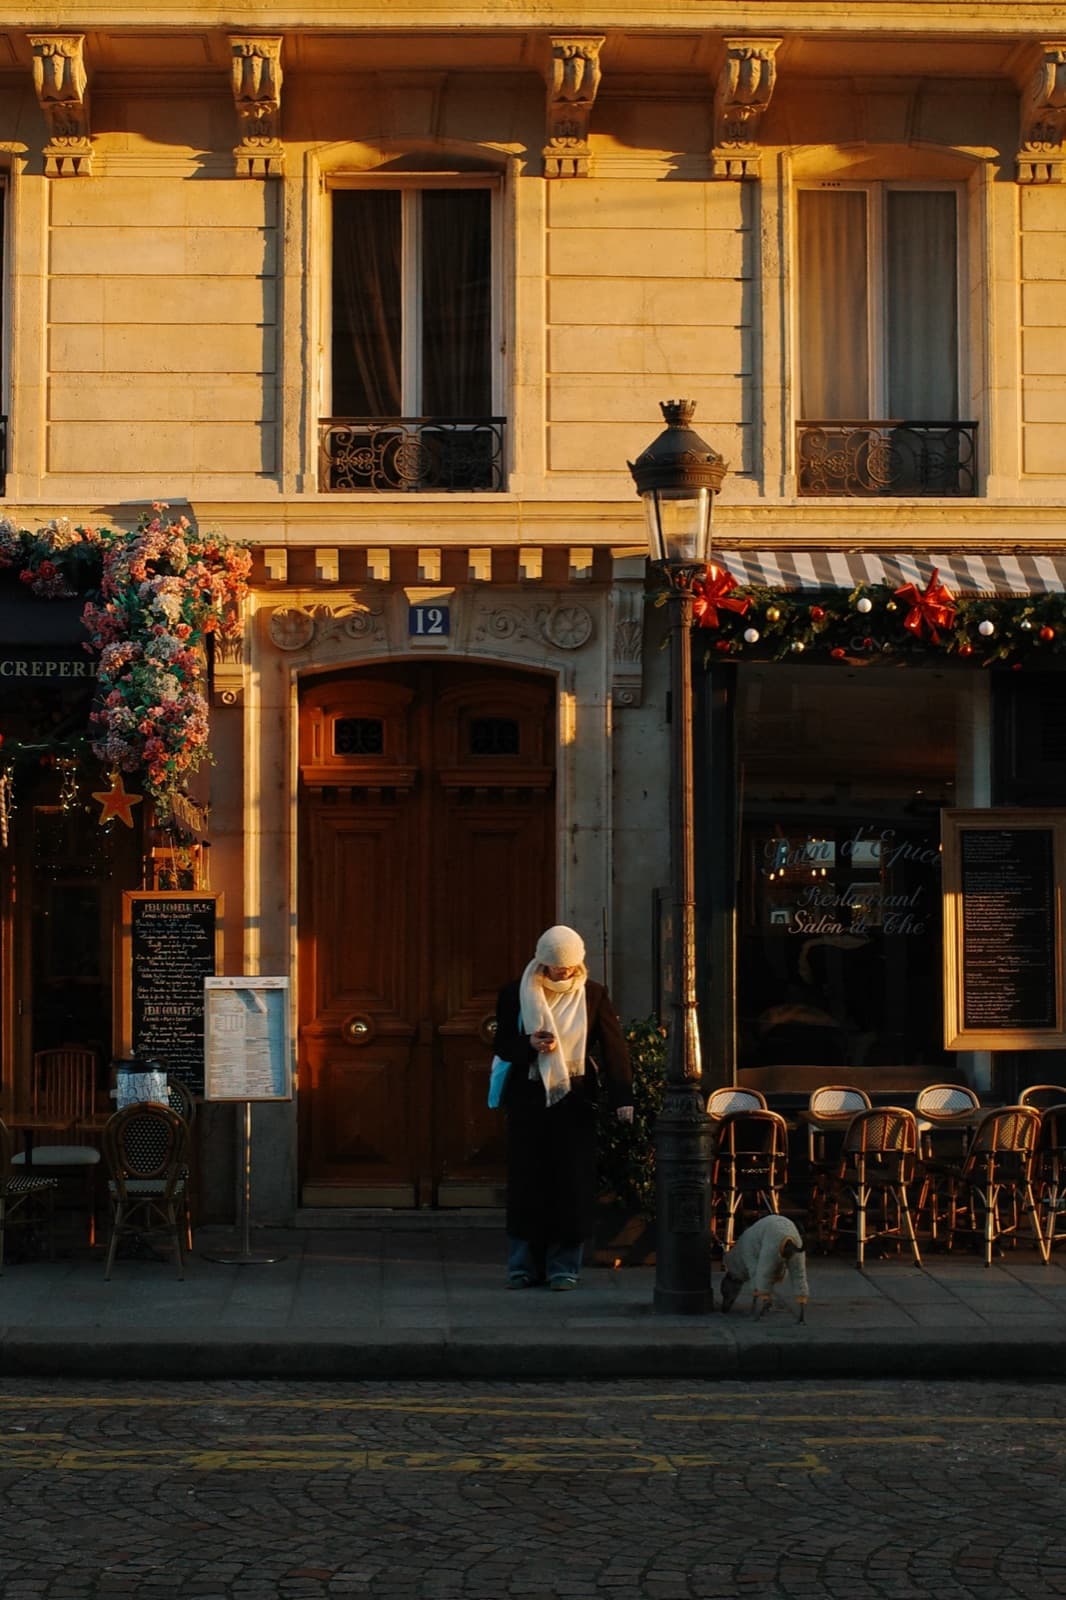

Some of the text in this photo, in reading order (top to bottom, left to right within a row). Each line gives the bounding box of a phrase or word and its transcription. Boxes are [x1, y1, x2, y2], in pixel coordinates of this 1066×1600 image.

[415, 608, 443, 634] 12
[0, 660, 96, 678] CREPERI
[797, 883, 922, 907] Restaurant
[788, 909, 844, 935] Salon
